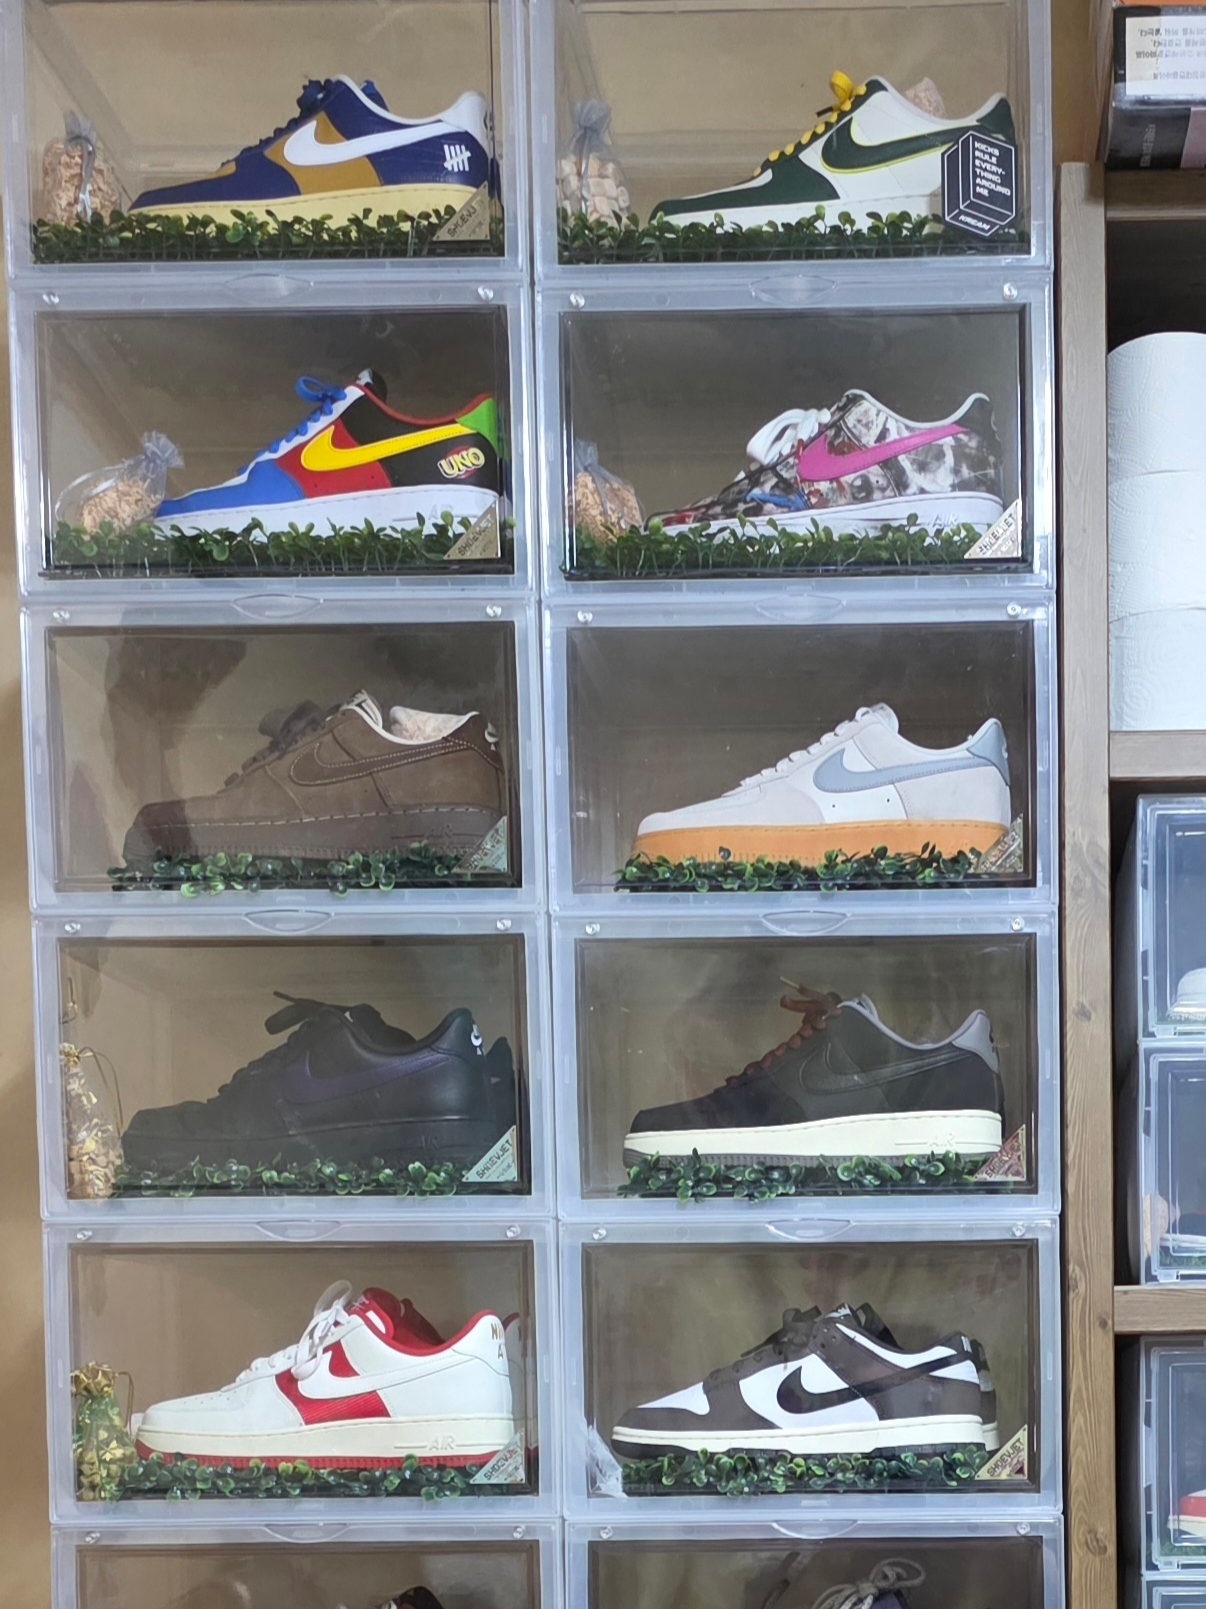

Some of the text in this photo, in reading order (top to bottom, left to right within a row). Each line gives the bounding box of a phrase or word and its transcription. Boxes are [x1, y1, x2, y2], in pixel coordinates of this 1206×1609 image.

[974, 141, 999, 156] KICKS
[975, 151, 997, 164] RULE
[975, 159, 1006, 175] EVERY-
[975, 168, 1001, 184] THING
[976, 178, 1011, 197] AROUND
[976, 186, 989, 197] ME
[437, 447, 485, 478] UNO
[476, 1139, 513, 1179] SHOEVJET
[428, 1434, 456, 1451] AIR
[987, 1437, 1022, 1478] SHOEVJET
